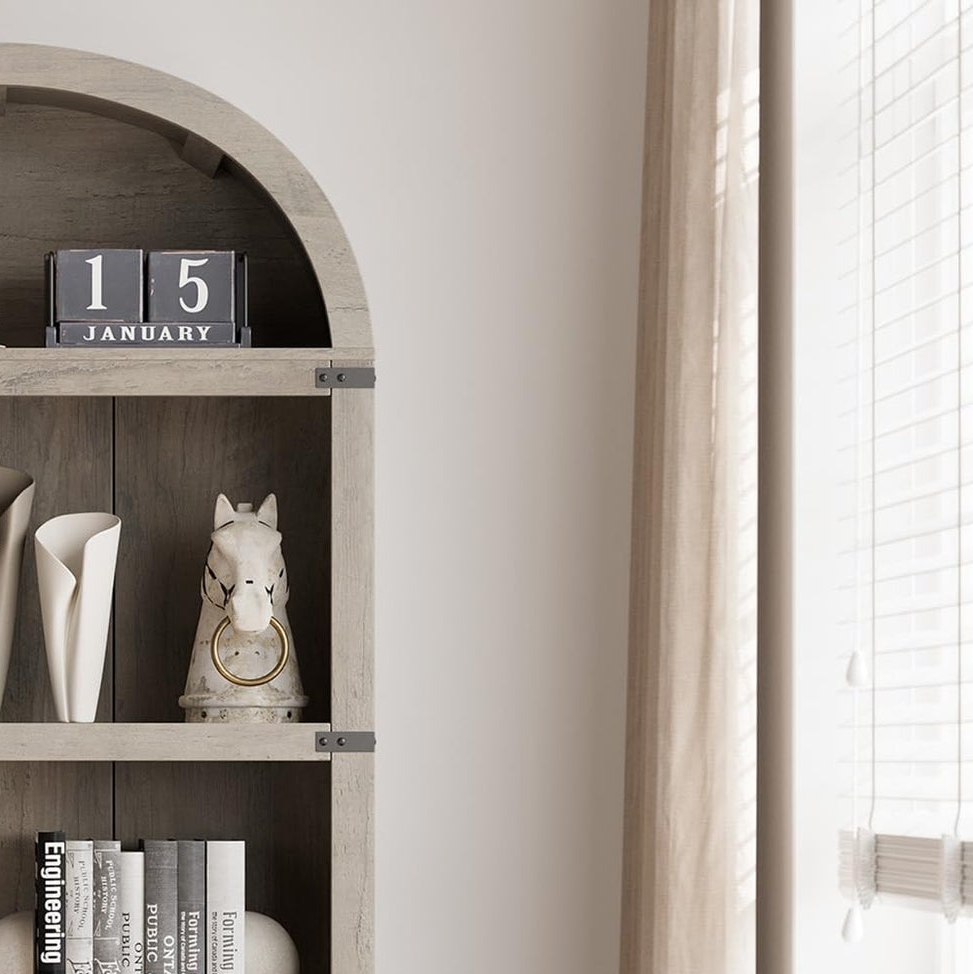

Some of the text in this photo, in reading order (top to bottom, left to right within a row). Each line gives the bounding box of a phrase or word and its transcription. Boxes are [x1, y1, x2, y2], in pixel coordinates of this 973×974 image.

[84, 254, 209, 313] 1 5
[83, 326, 212, 341] JANUARY
[40, 842, 65, 964] Engineering
[122, 912, 130, 967] PUBLIC
[147, 904, 158, 963] PUBLIC
[187, 911, 200, 970] Forming
[220, 911, 238, 970] Forming
